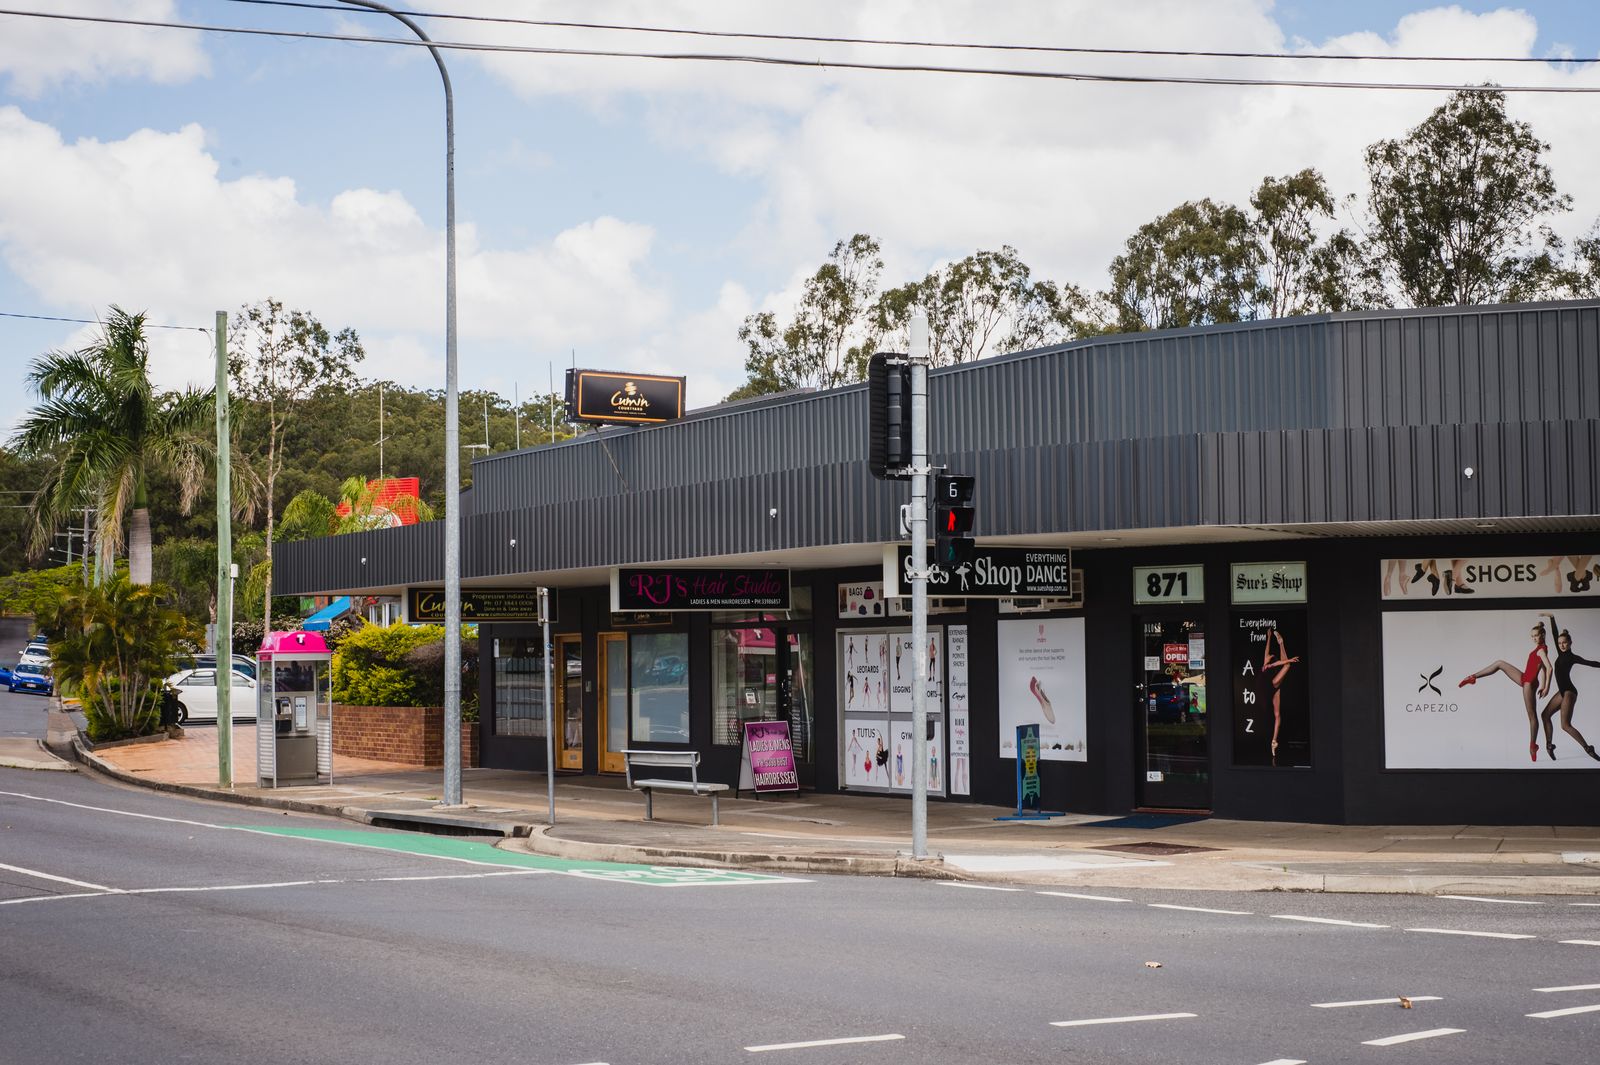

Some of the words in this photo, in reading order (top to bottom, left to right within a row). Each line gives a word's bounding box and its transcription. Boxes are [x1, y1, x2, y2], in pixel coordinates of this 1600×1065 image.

[610, 390, 650, 407] Cumin
[949, 482, 958, 498] 6
[1026, 553, 1067, 563] EVERYTHING
[974, 556, 1022, 593] Shop
[1026, 565, 1067, 583] DANCE
[1465, 564, 1537, 583] SHOES
[630, 574, 688, 604] RJ's
[693, 572, 728, 596] Hair
[732, 572, 782, 596] Studio
[1146, 572, 1188, 597] 871
[1236, 572, 1268, 590] Sue's
[1271, 572, 1302, 592] Shop
[849, 587, 863, 596] BAGS
[1239, 618, 1277, 630] Everything
[1250, 632, 1266, 642] from
[1166, 653, 1187, 661] OPEN
[856, 666, 879, 674] LEOTARDS
[1242, 660, 1255, 676] A
[1243, 688, 1256, 704] to
[1405, 703, 1459, 712] CAPEZIO
[857, 728, 875, 738] TUTUS
[1245, 718, 1254, 733] Z
[750, 740, 768, 752] LADIES
[773, 738, 790, 751] MENS
[755, 771, 796, 786] HAIRDRESSER
